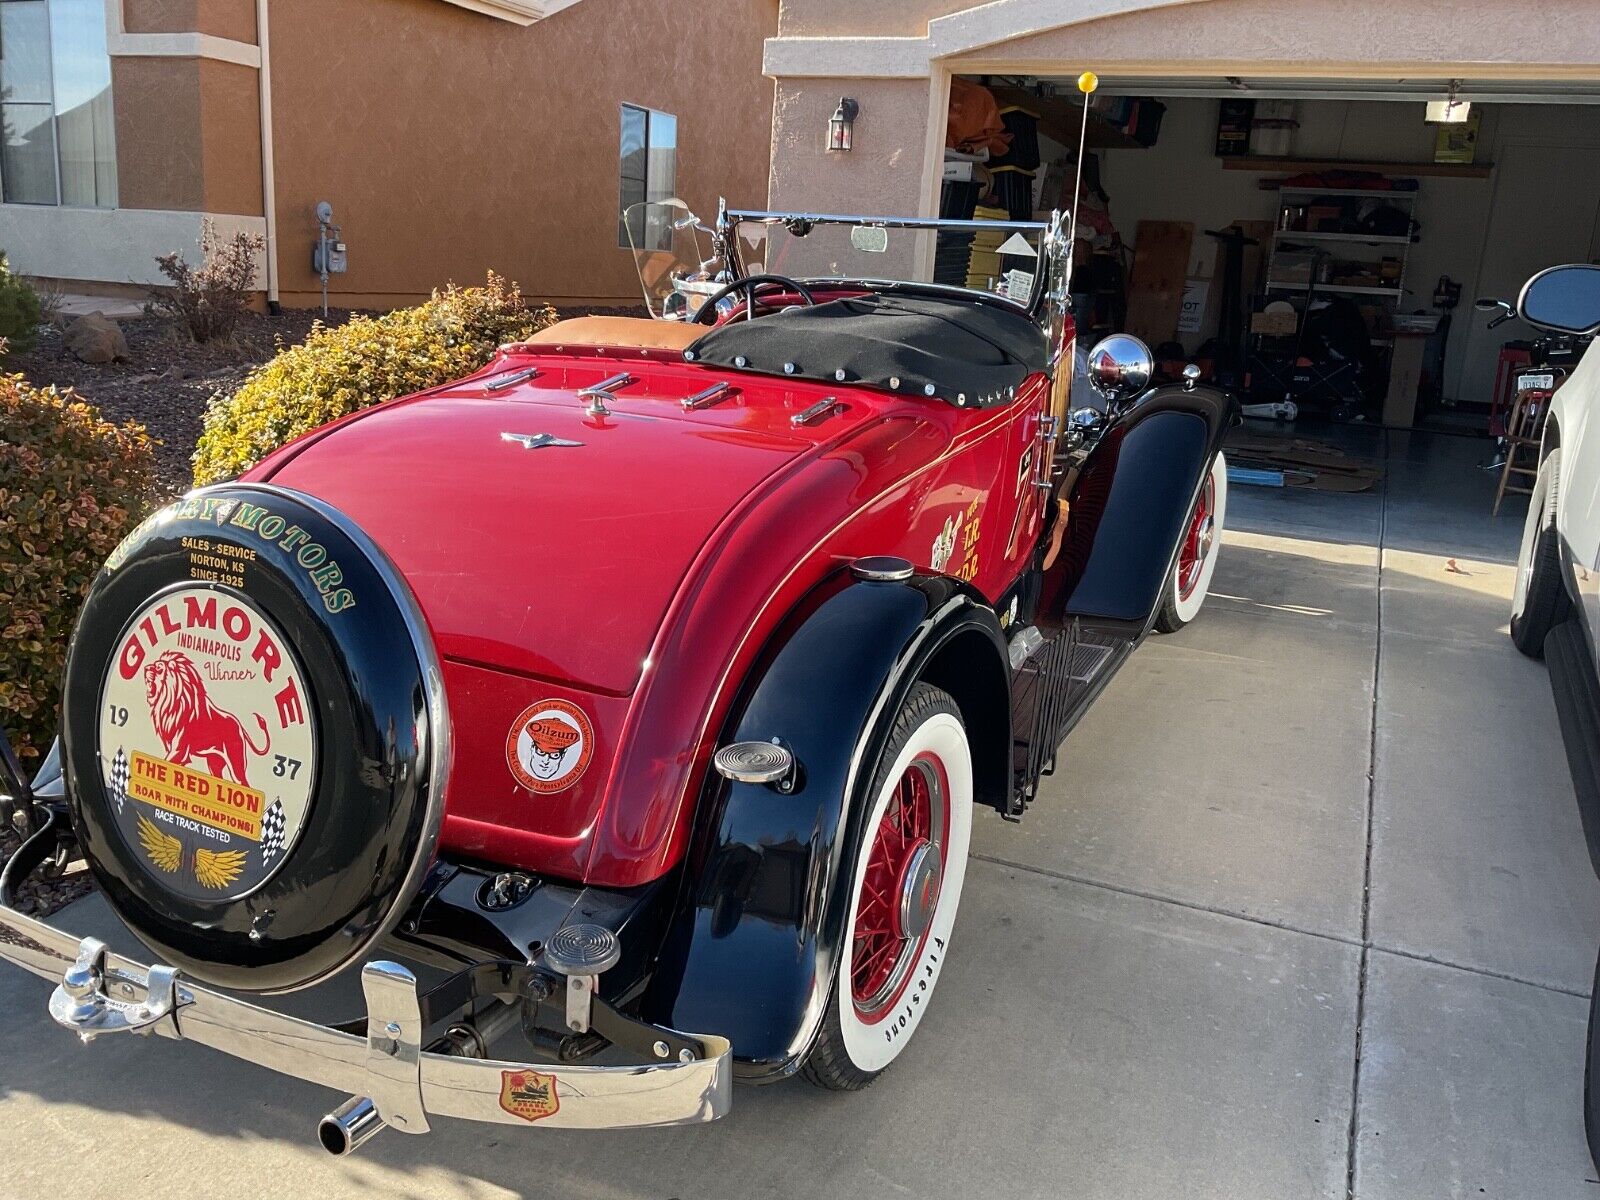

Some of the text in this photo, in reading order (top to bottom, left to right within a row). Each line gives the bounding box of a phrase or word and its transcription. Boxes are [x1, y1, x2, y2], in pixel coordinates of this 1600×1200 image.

[182, 537, 210, 551] SALES
[216, 544, 256, 561] SERVICE
[231, 502, 355, 614] MOTORS
[190, 553, 245, 574] NORTON, KS
[190, 568, 244, 588] SINCE 1925
[177, 631, 242, 662] INDIANAPOLIS
[118, 596, 304, 729] GILMORE
[203, 661, 257, 682] Winner
[110, 704, 128, 728] 19
[530, 722, 578, 740] Oilzum
[272, 754, 302, 780] 37
[136, 758, 260, 813] THE RED LION
[135, 784, 254, 834] ROAR WITH CHAMPIONS!
[154, 808, 230, 844] RACE TRACK TESTED
[885, 937, 944, 1042] Firestone
